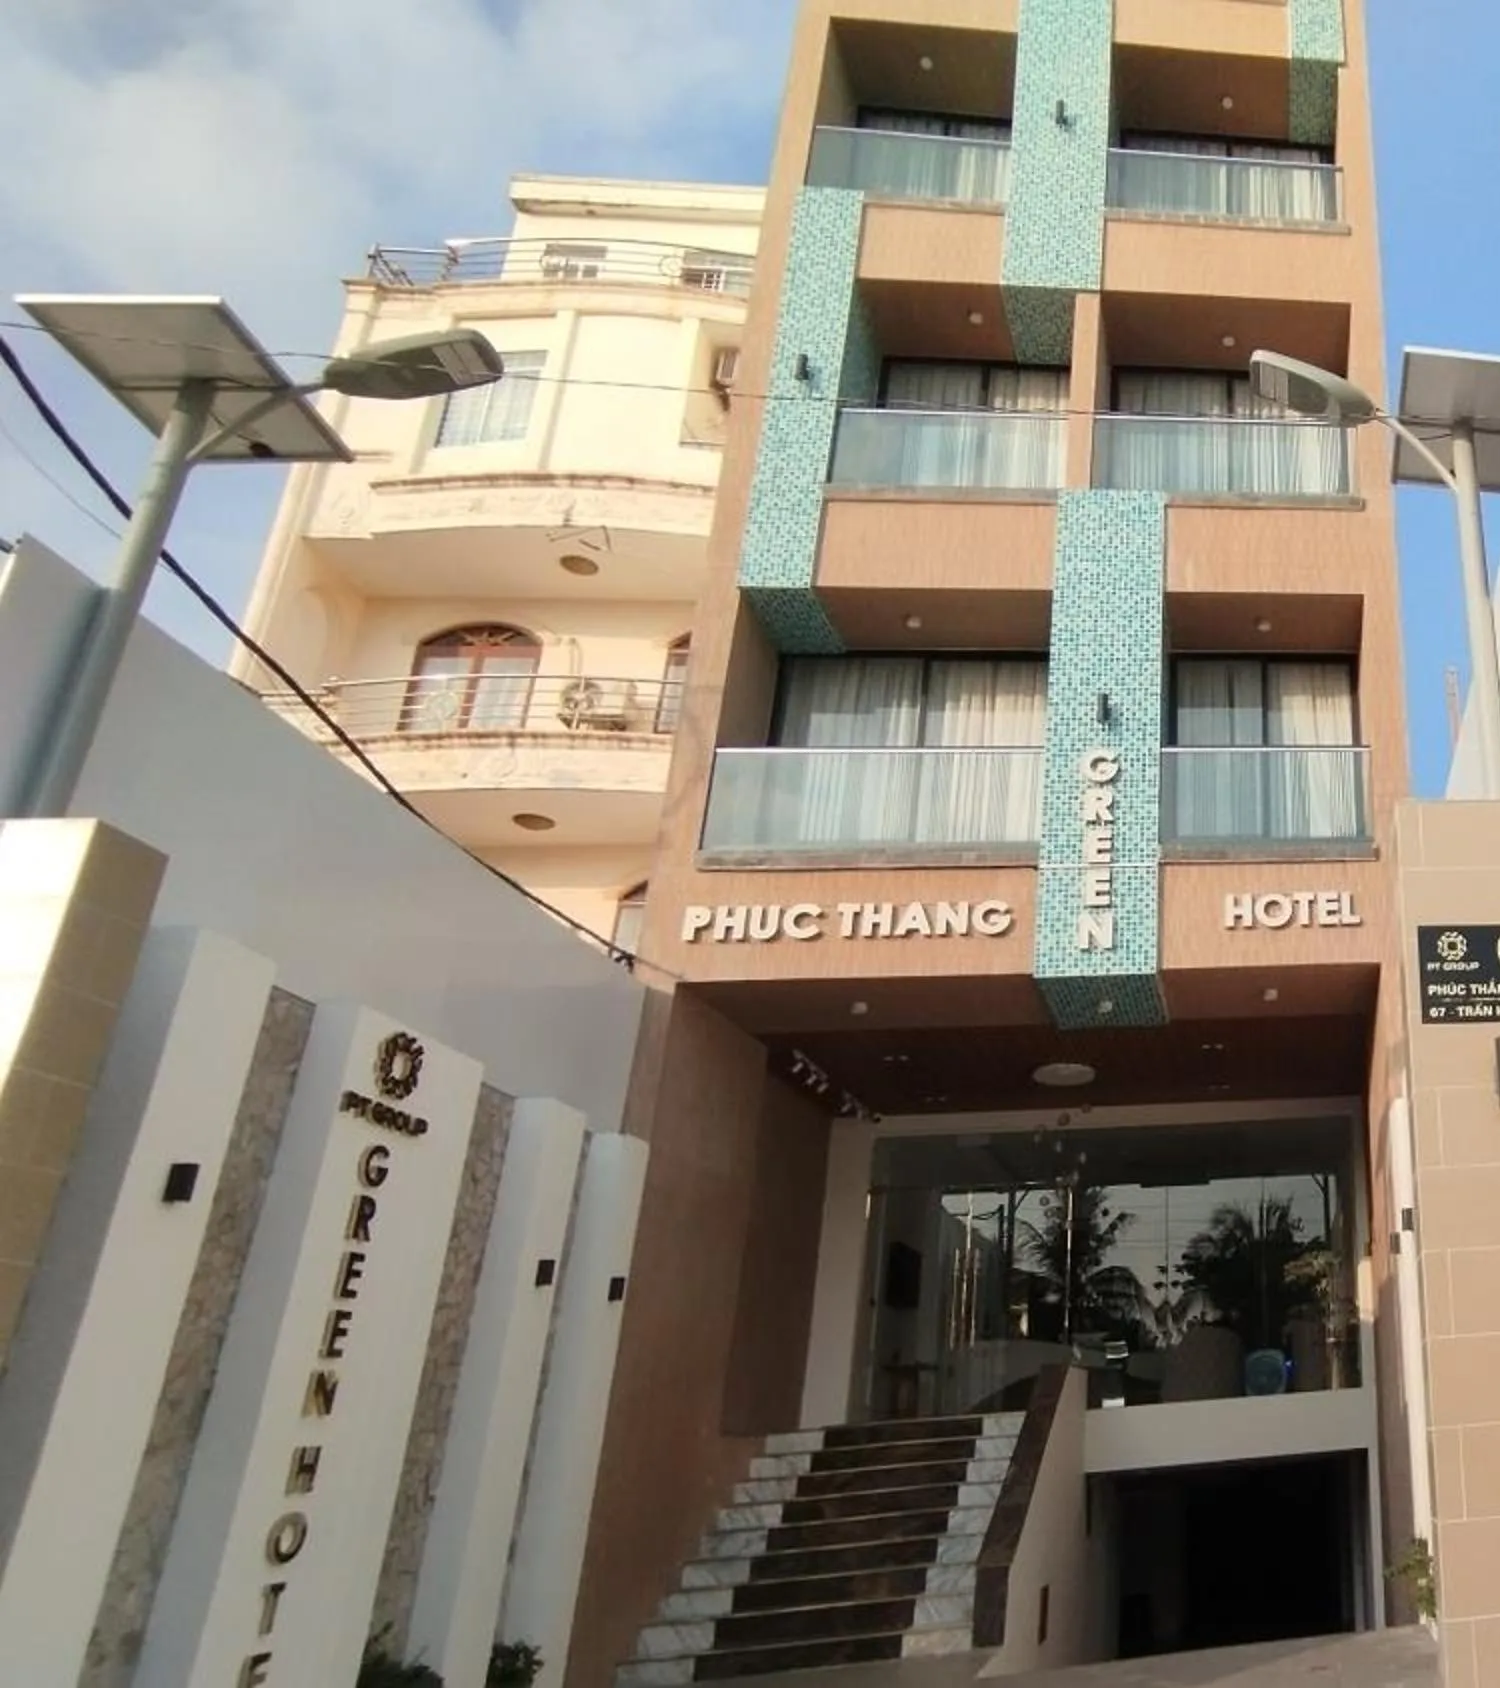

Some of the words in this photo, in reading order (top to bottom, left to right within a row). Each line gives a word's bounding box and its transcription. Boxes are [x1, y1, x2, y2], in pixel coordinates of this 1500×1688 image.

[1078, 748, 1120, 950] GREEN
[682, 903, 824, 943] PHUC
[837, 900, 1013, 938] THANG
[1224, 890, 1362, 930] HOTEL
[1443, 961, 1480, 971] GROUP
[1429, 1007, 1447, 1018] 67
[369, 1101, 428, 1137] GROUP
[302, 1145, 390, 1418] GREEN
